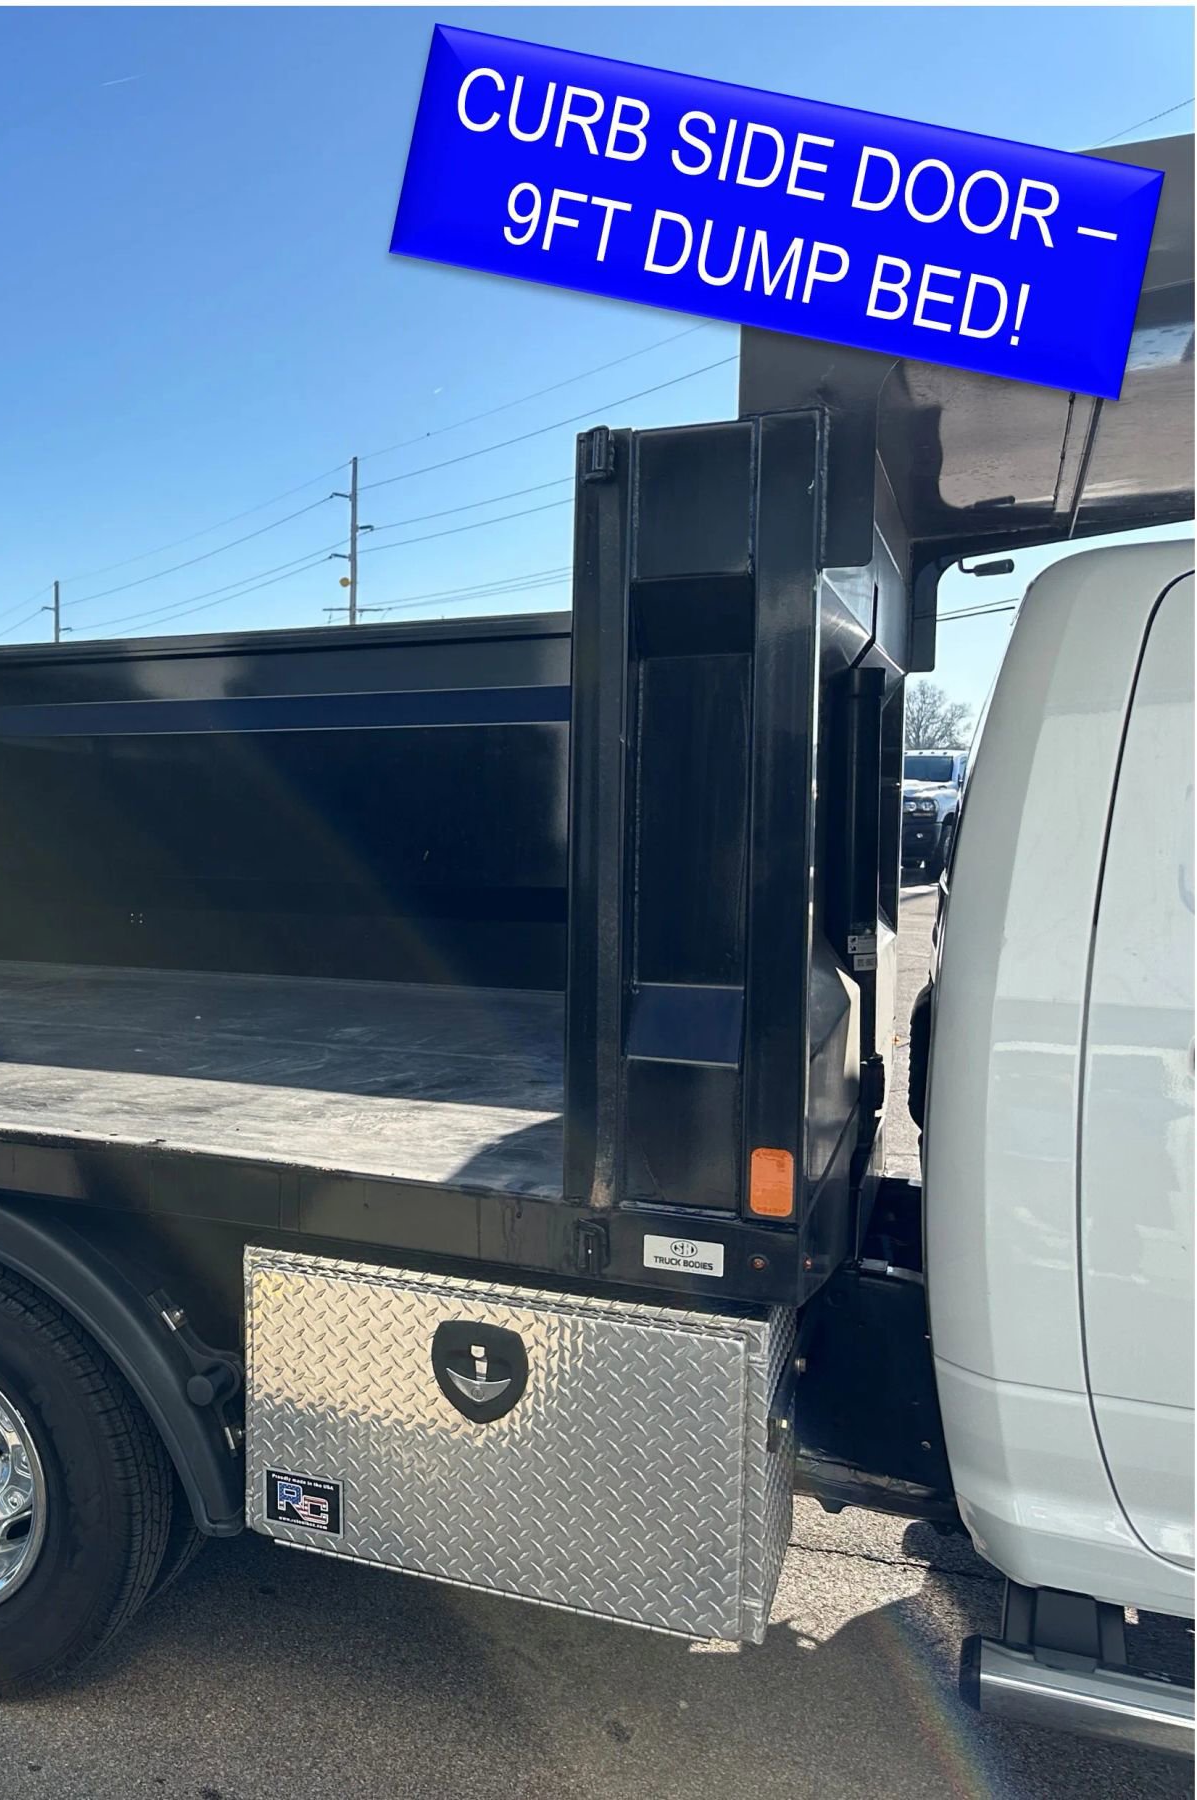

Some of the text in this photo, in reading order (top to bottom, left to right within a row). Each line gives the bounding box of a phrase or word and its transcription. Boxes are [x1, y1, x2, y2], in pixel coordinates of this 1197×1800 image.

[653, 1256, 714, 1271] TRUCK BODIES
[277, 1481, 329, 1524] RC
